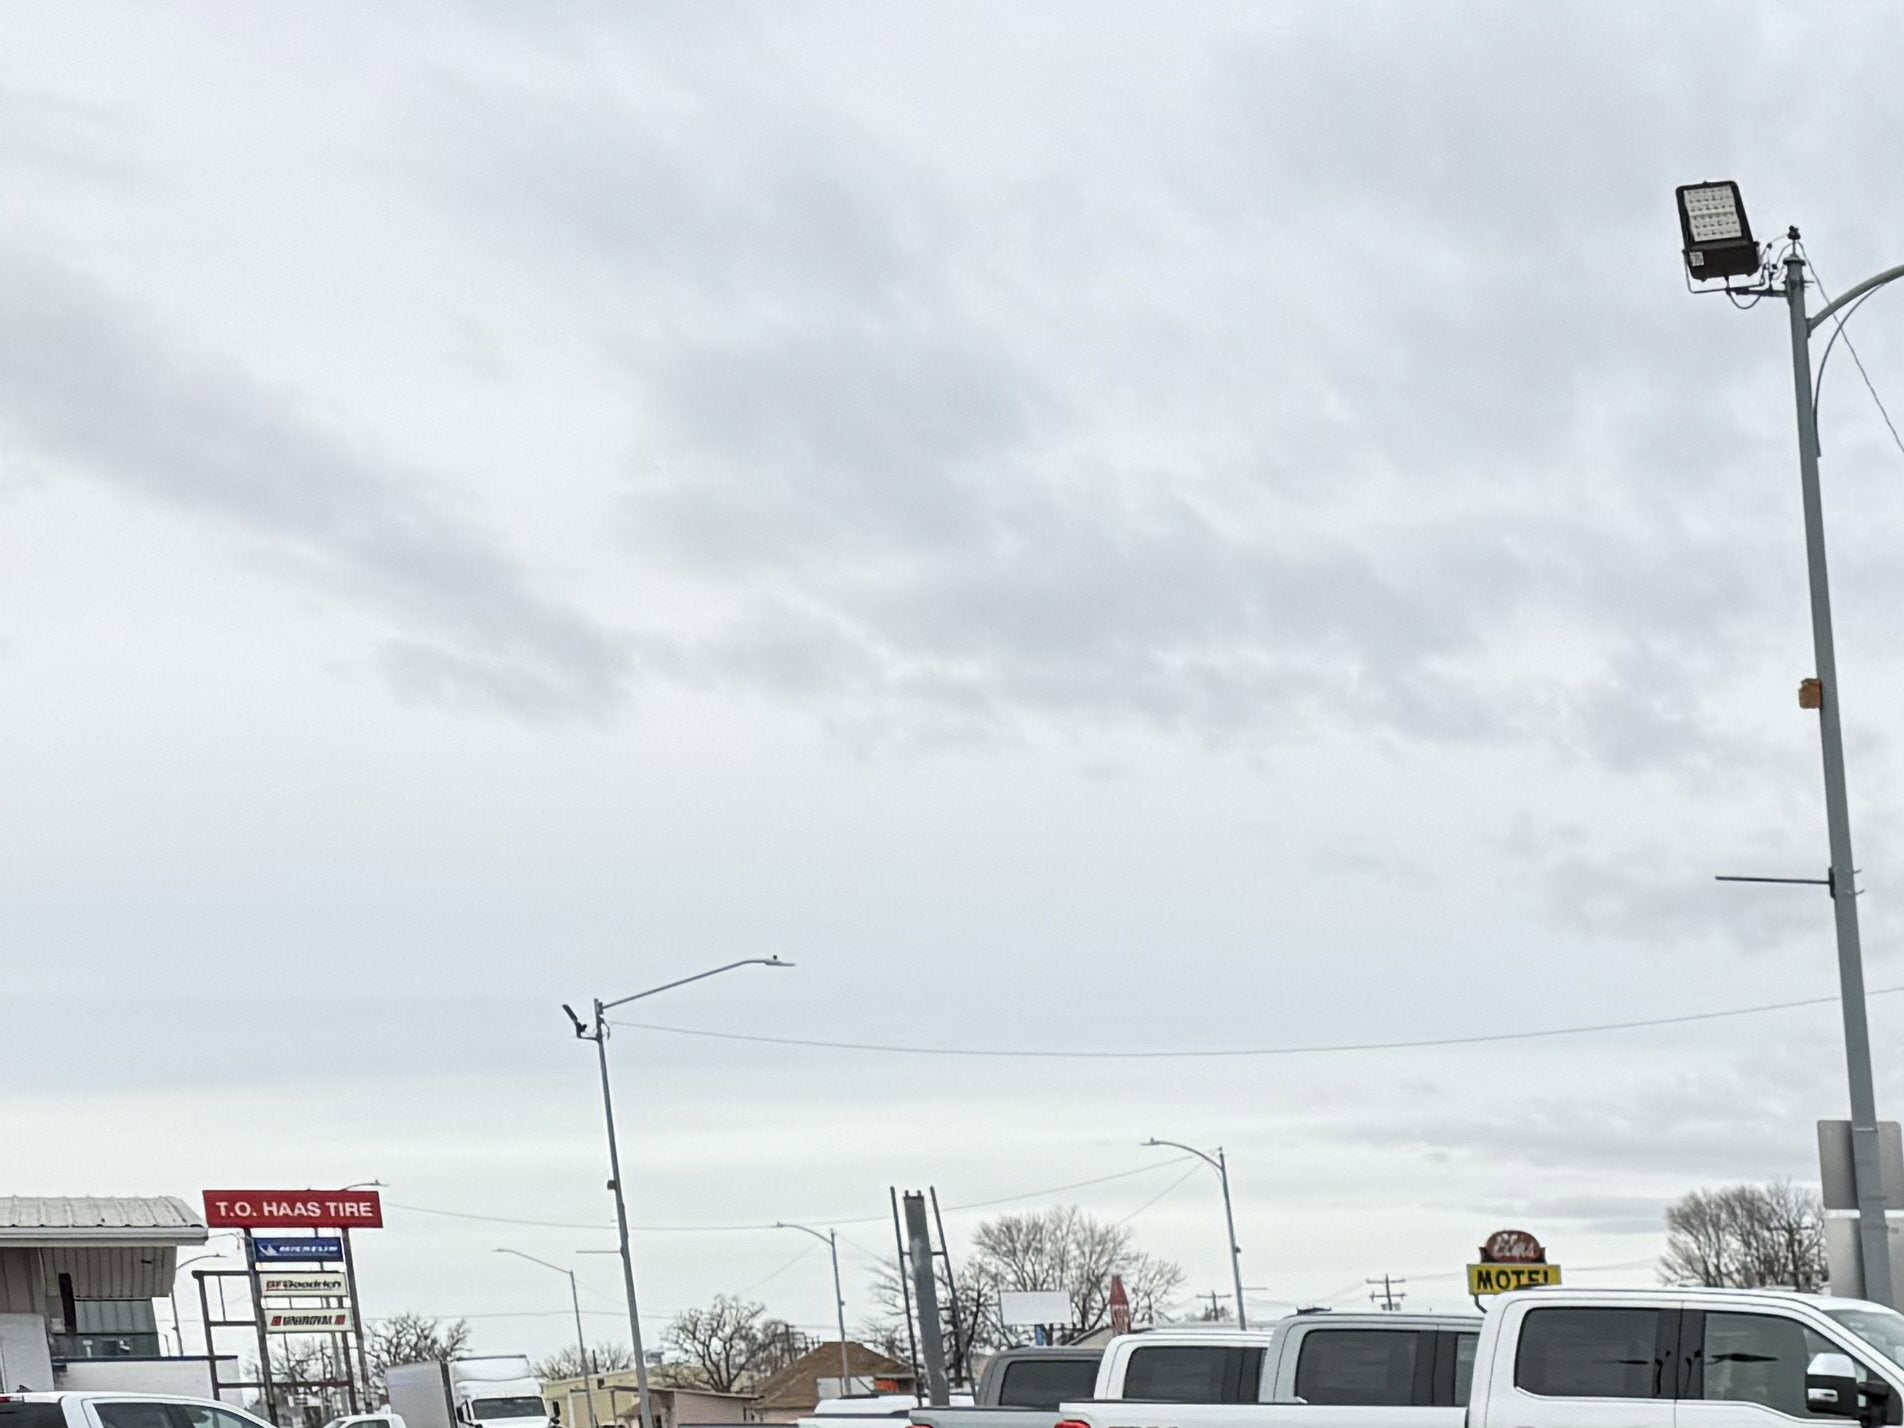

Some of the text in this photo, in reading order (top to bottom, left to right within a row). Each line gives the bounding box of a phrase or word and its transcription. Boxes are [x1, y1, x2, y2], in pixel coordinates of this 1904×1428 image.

[216, 1202, 373, 1217] T.O. HAAS TIRE
